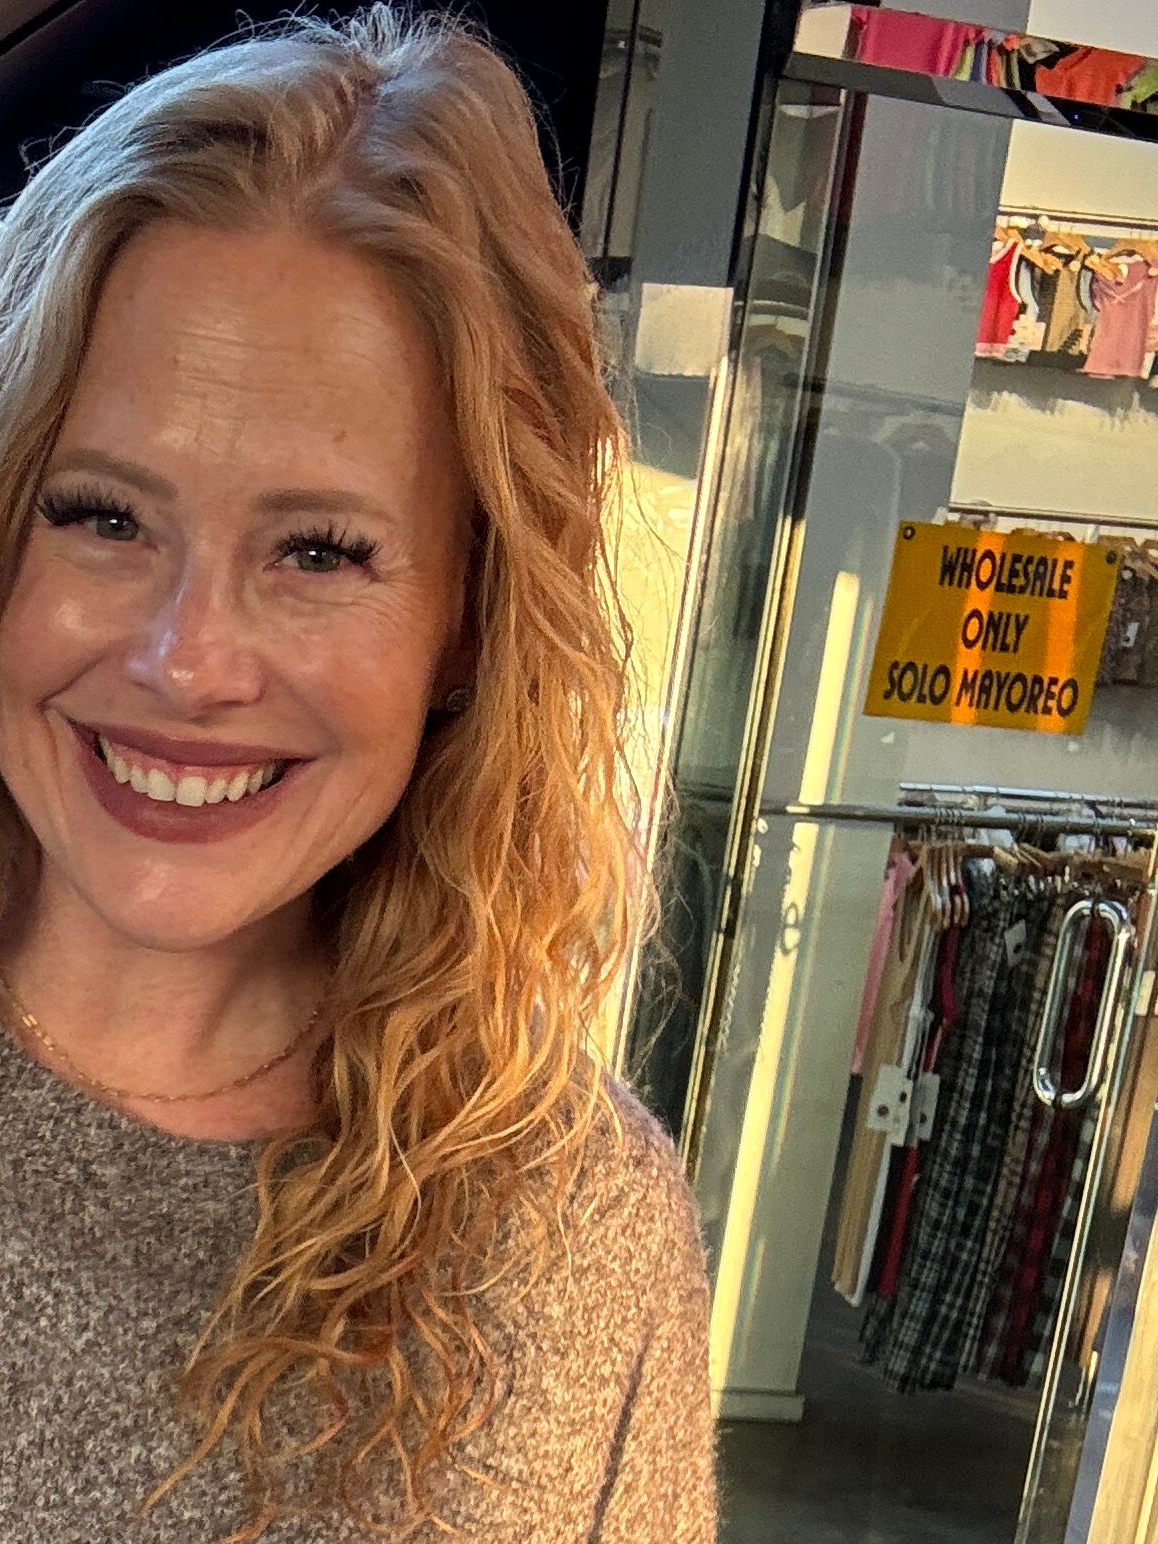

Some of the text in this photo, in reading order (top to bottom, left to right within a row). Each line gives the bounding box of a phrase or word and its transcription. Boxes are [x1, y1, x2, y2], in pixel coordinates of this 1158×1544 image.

[938, 544, 1076, 600] WHOLESALE
[960, 607, 1030, 655] ONLY
[882, 660, 1080, 719] SOLO MAYOREO
